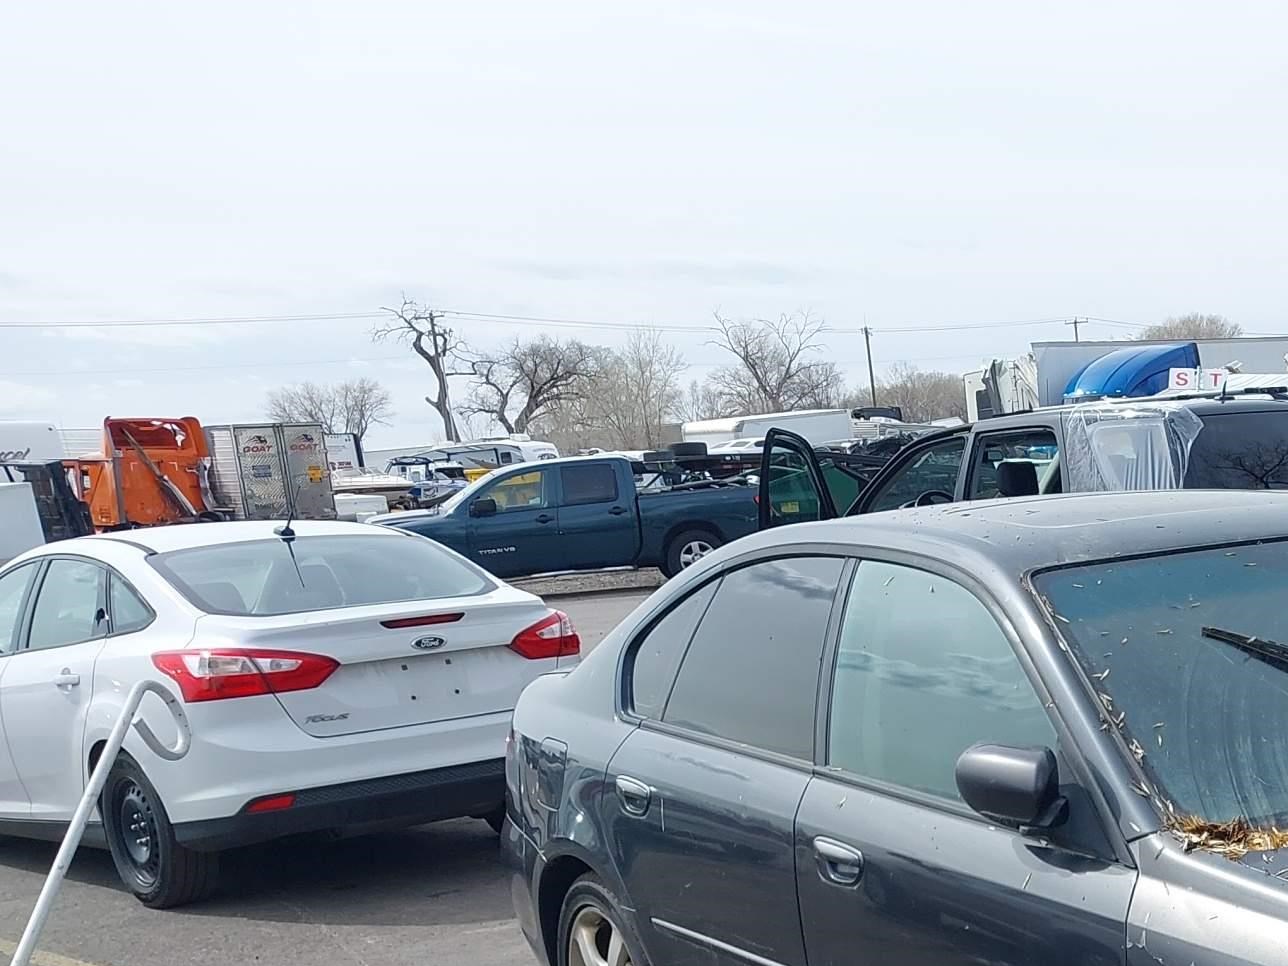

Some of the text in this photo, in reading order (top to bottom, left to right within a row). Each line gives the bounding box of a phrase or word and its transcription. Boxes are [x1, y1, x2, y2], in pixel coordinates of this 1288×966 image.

[1175, 372, 1188, 386] S
[1210, 373, 1222, 387] T
[243, 445, 273, 453] GOAT
[290, 443, 319, 452] GOAT
